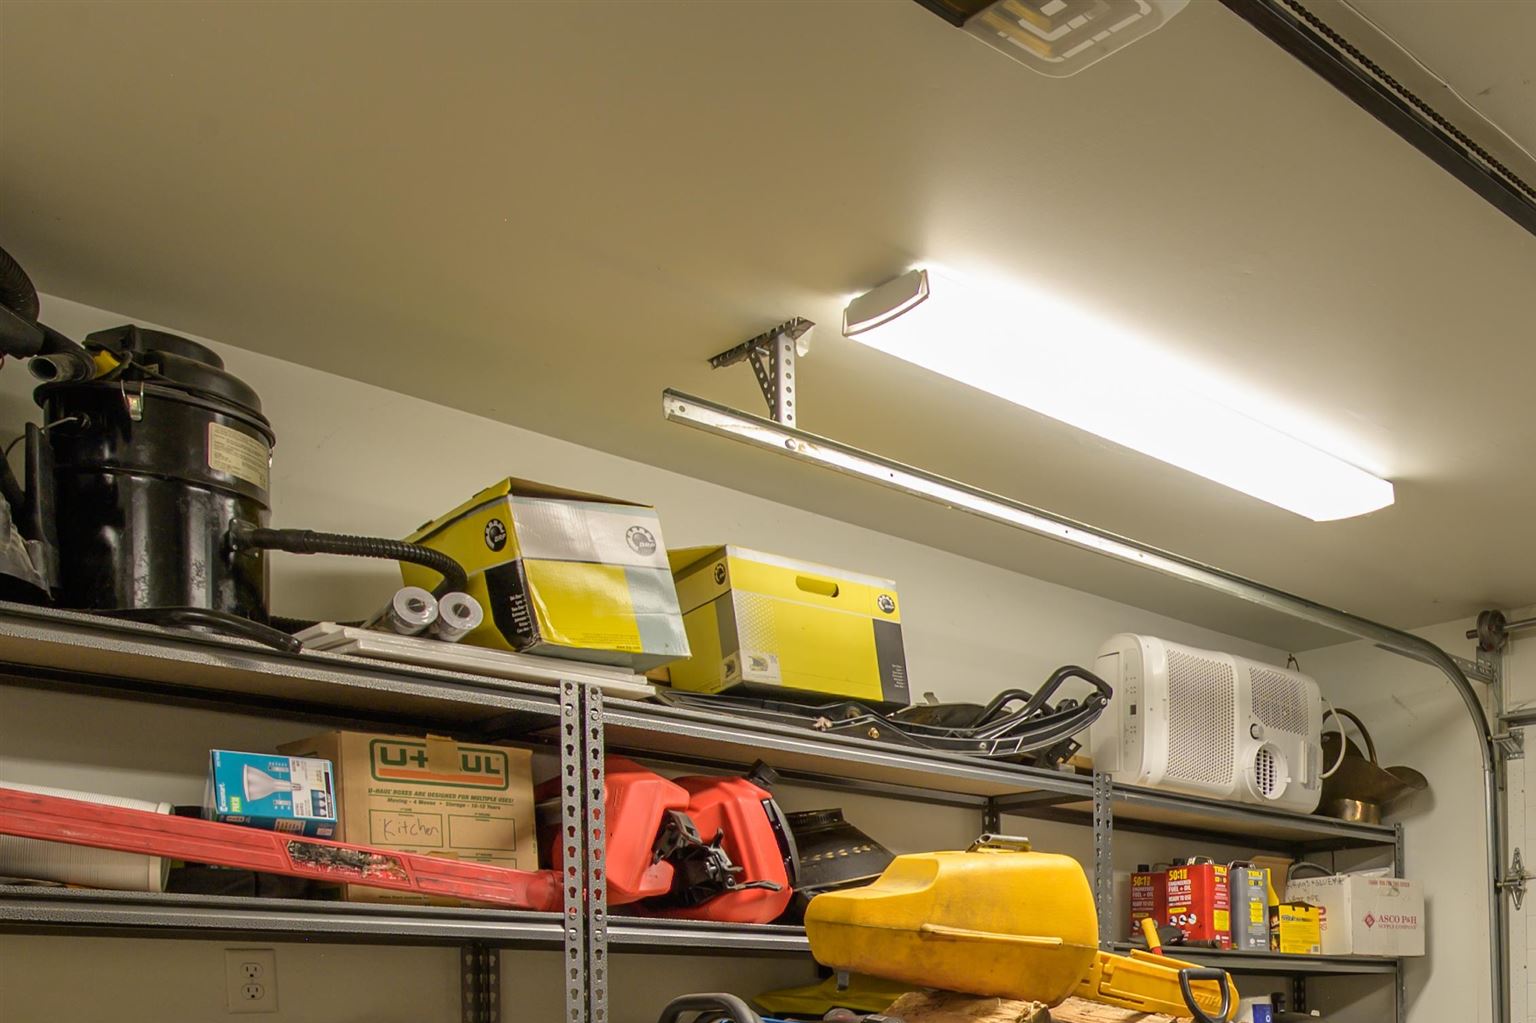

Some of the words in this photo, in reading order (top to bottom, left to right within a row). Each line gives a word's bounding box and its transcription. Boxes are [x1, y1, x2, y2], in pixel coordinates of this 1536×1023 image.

[380, 747, 501, 775] U-UL
[383, 817, 439, 841] Kitchen
[1378, 914, 1400, 923] ASCO
